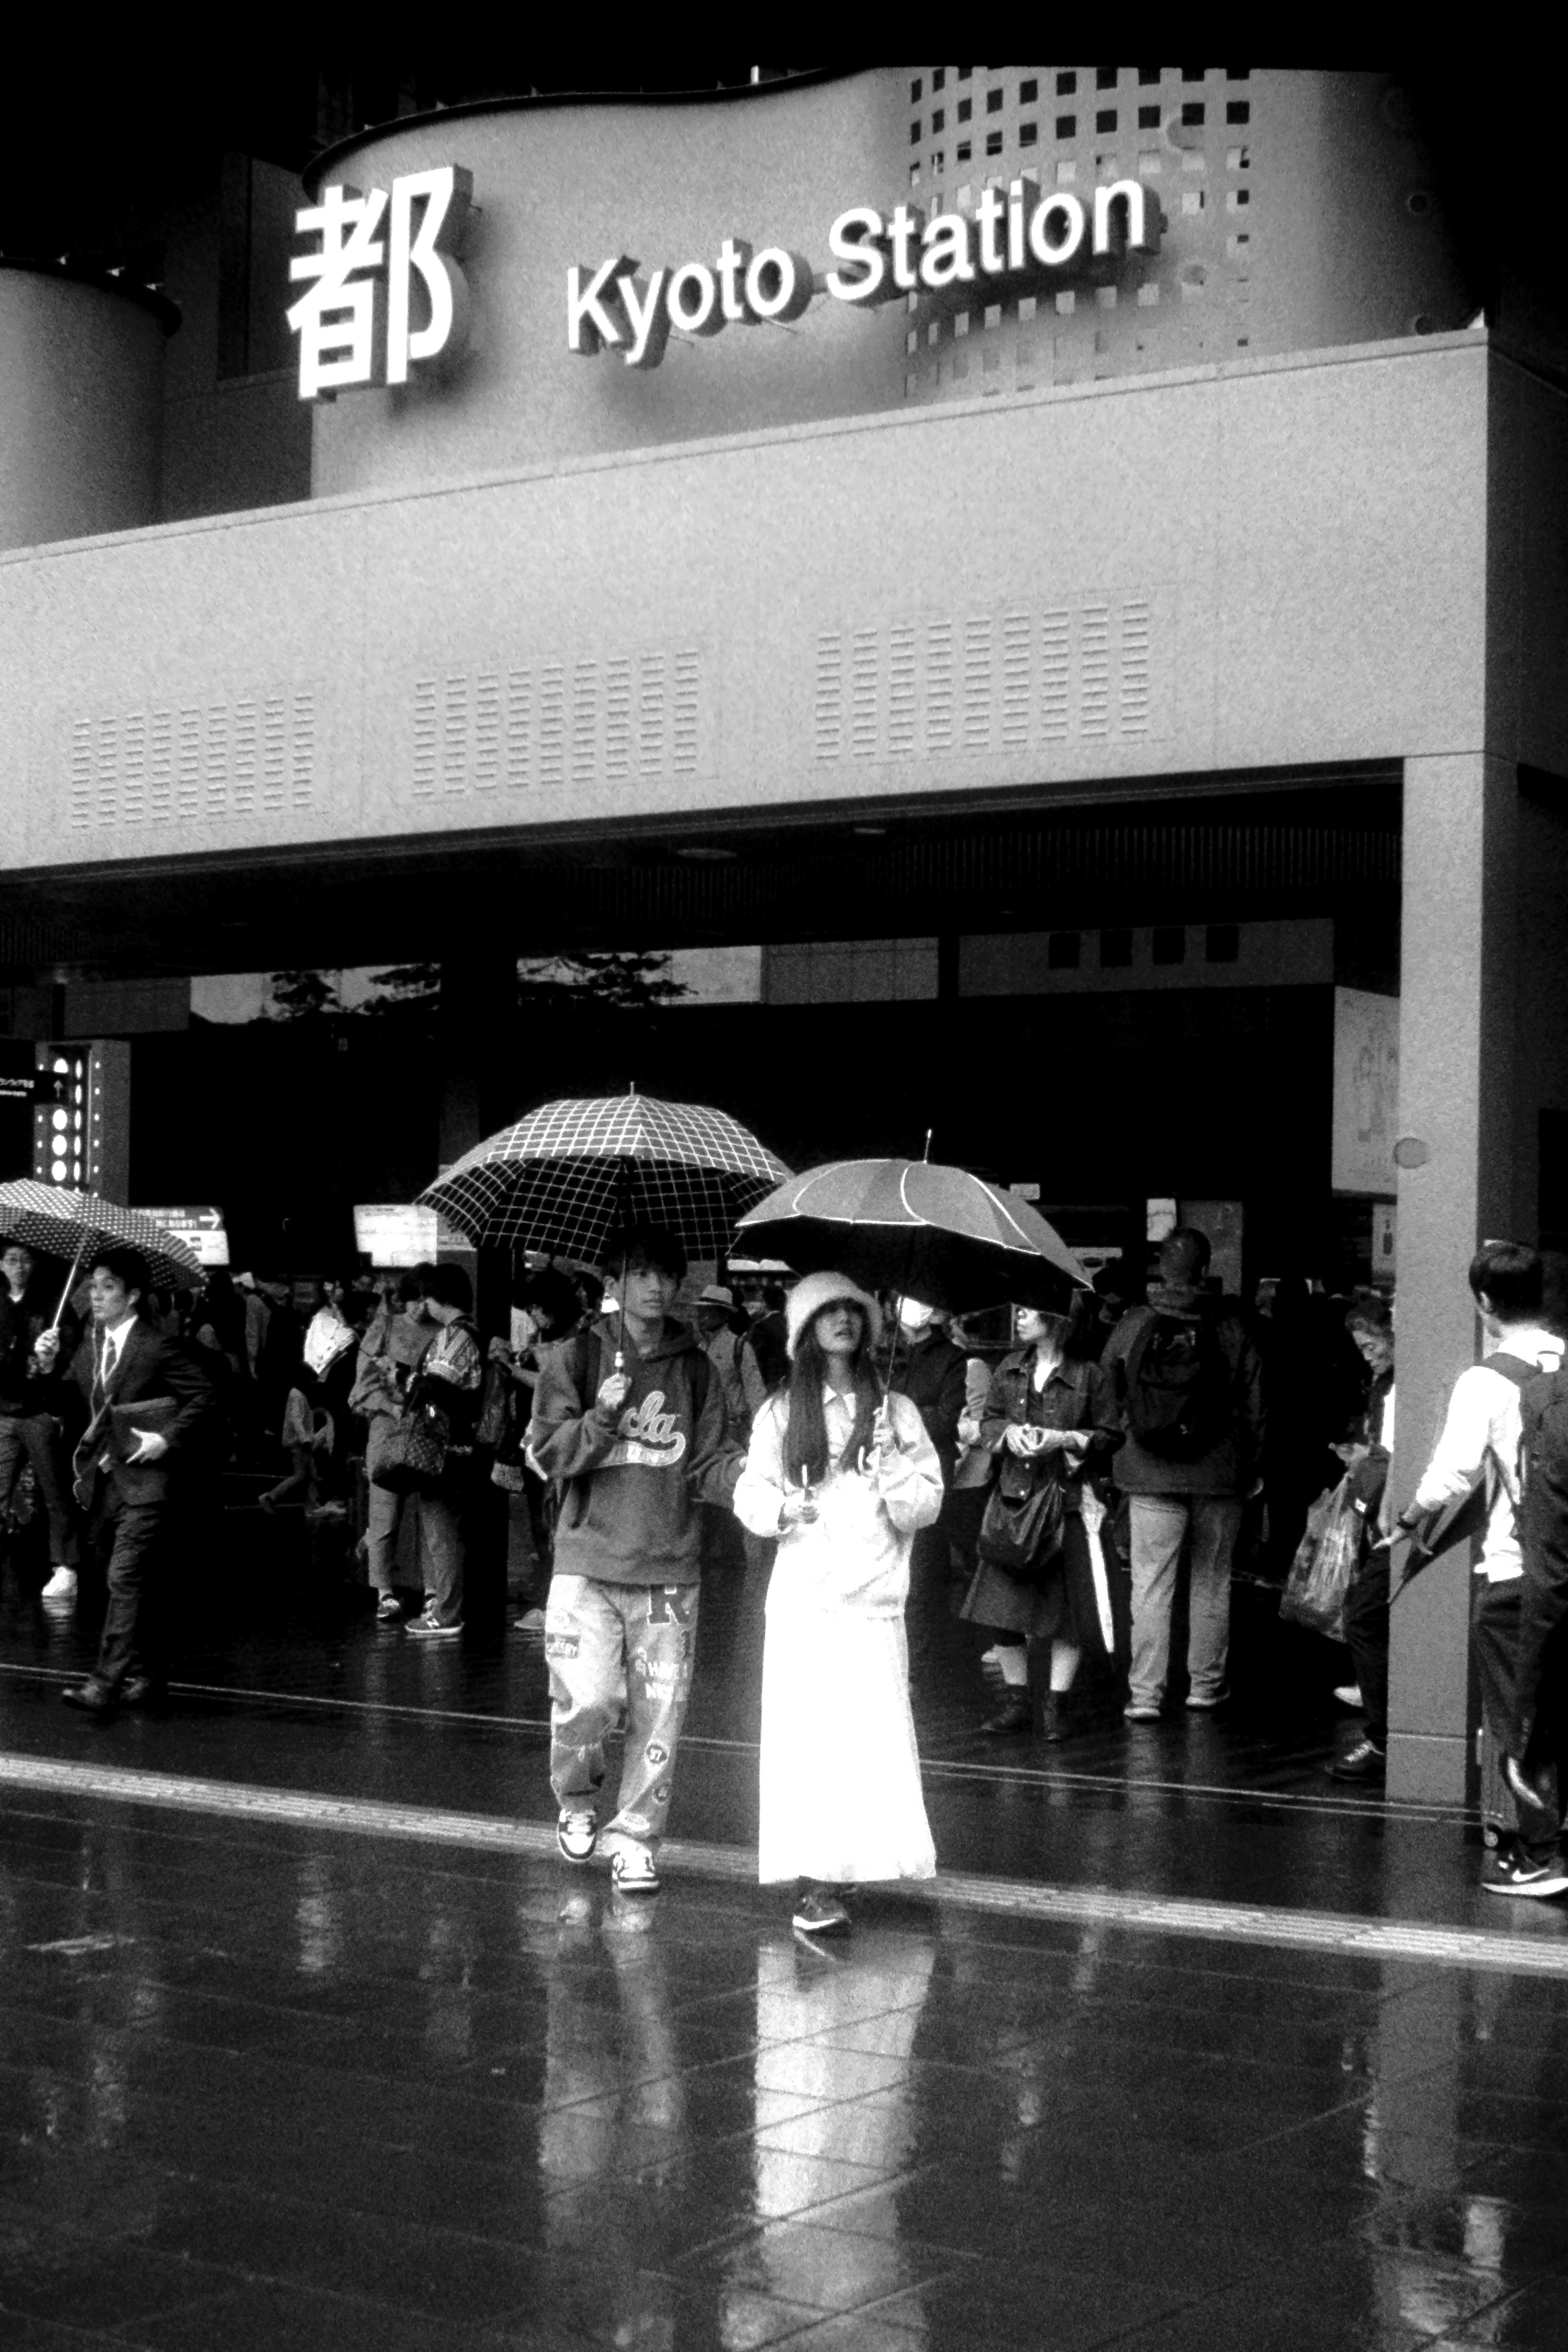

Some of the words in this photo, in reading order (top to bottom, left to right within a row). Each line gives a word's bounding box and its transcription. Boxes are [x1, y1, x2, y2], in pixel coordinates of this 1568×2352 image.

[287, 166, 453, 397] 都
[567, 239, 795, 363] Kyoto
[826, 180, 1145, 300] Station
